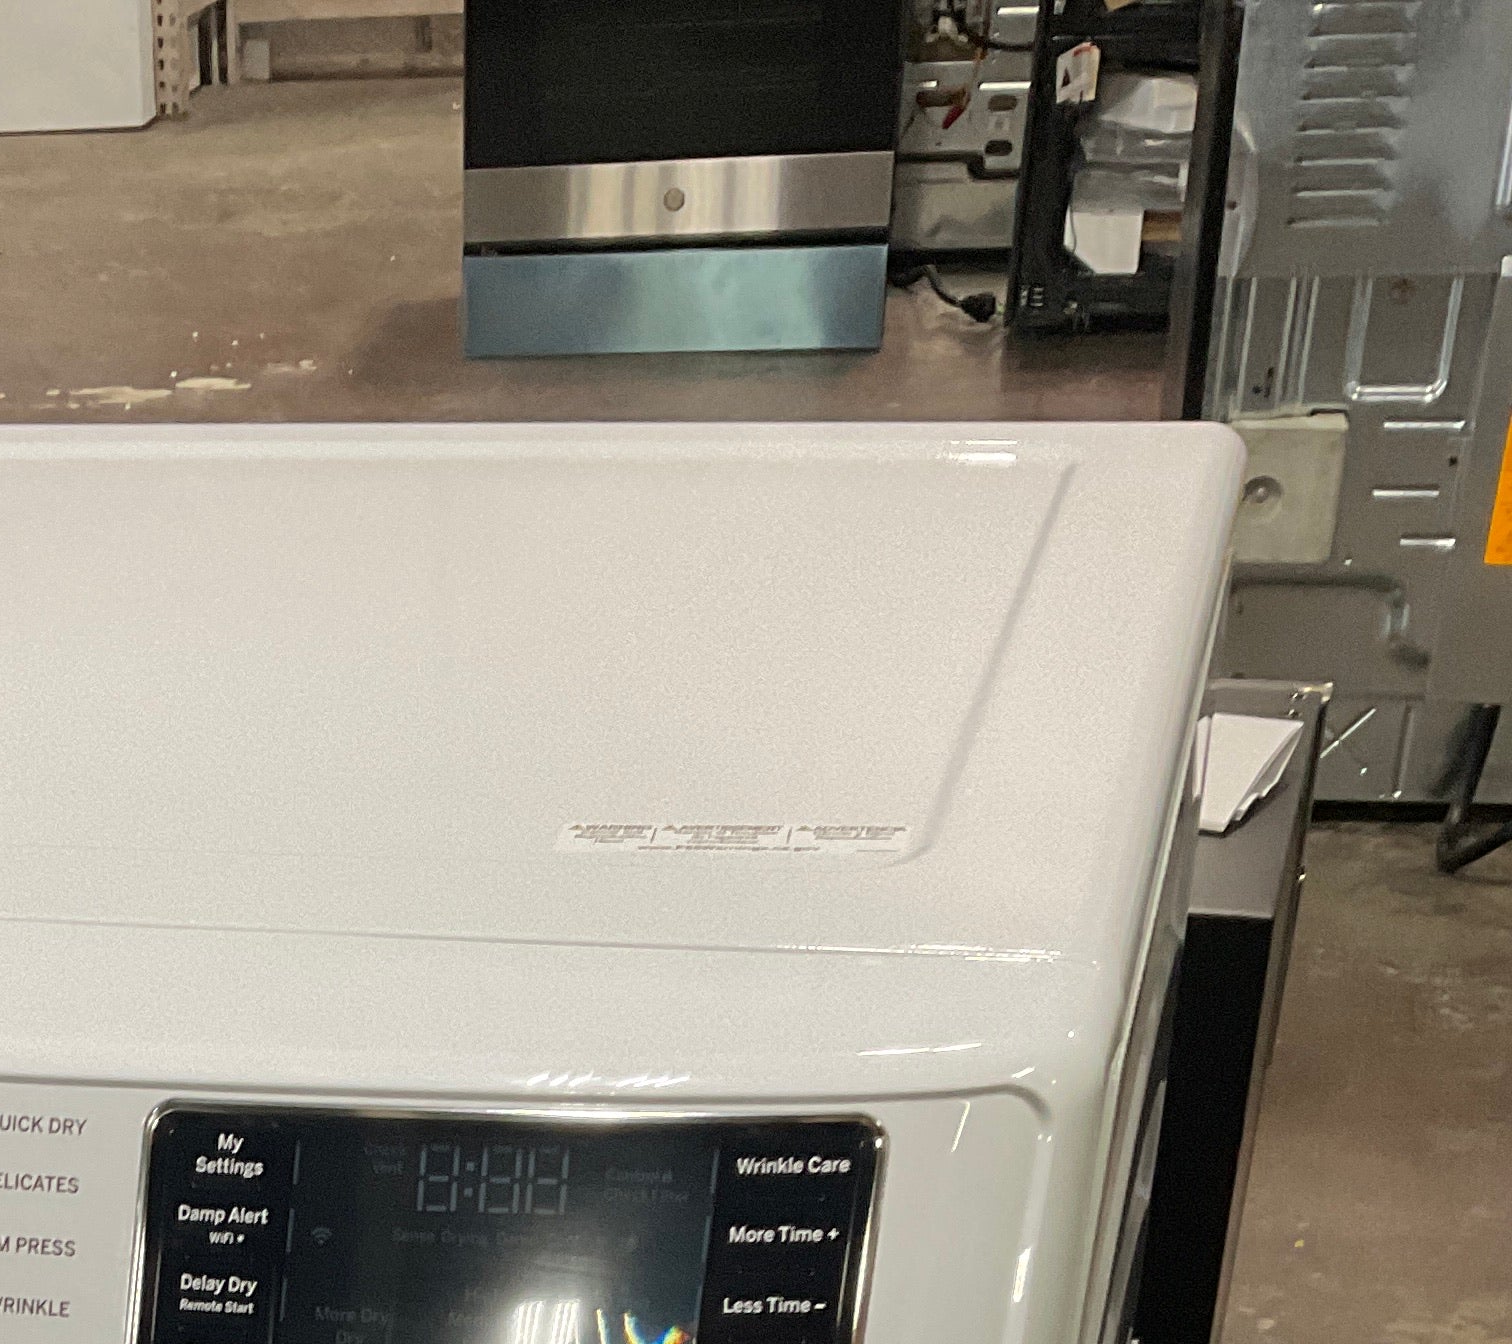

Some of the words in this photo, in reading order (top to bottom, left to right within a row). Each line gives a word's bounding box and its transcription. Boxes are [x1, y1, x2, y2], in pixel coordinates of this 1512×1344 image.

[48, 1116, 88, 1136] DRY
[217, 1133, 245, 1154] My
[195, 1155, 264, 1179] Settings
[737, 1156, 805, 1175] Wrinkle
[808, 1155, 852, 1174] Care
[177, 1204, 227, 1226] Damp
[228, 1206, 269, 1225] Alert
[729, 1225, 776, 1243] More
[778, 1225, 824, 1243] Time
[15, 1237, 76, 1257] PRESS
[180, 1272, 227, 1296] Delay
[228, 1275, 258, 1298] Dry
[179, 1298, 223, 1313] Remote
[224, 1300, 255, 1315] Start
[723, 1297, 764, 1314] Less
[766, 1296, 812, 1314] Time
